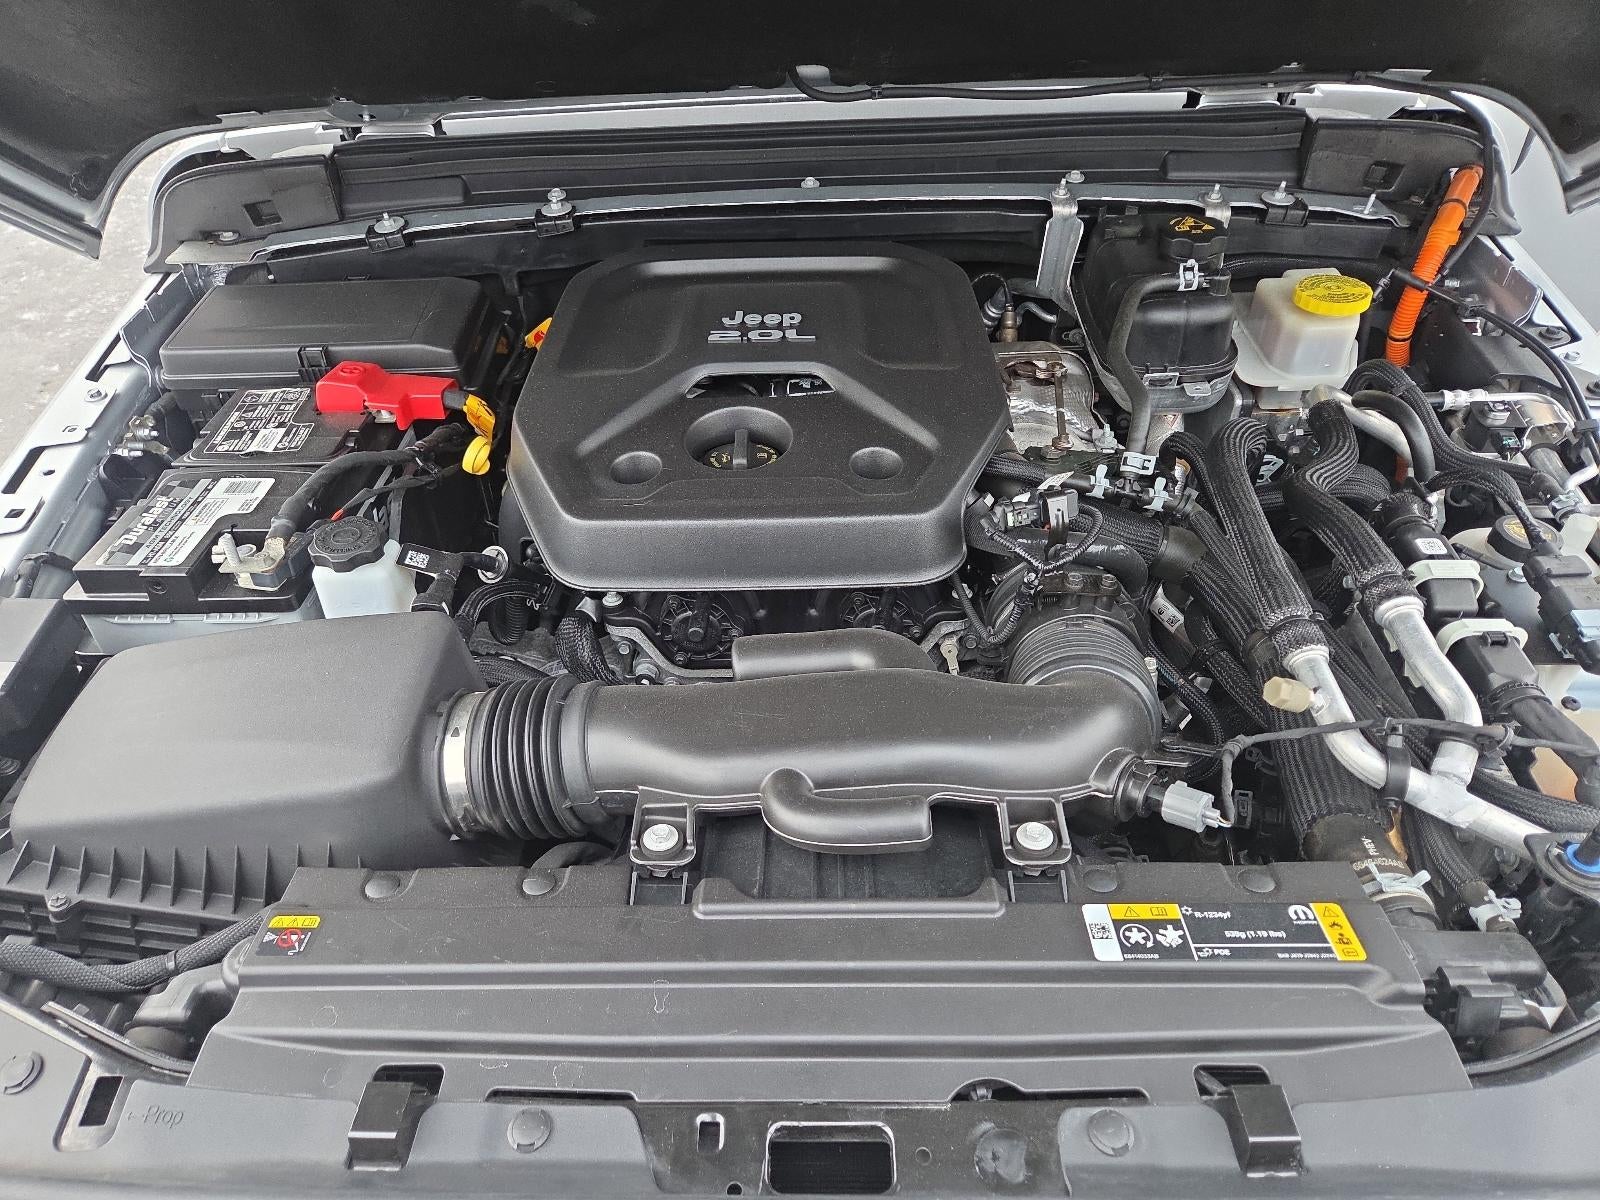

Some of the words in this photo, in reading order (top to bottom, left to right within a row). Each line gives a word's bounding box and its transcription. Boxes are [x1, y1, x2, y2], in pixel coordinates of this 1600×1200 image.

[721, 310, 802, 328] Jeep
[707, 329, 816, 343] 2.0L
[120, 494, 176, 546] Duralast
[145, 534, 161, 549] AGM
[160, 496, 194, 535] TECHNOLOGY
[147, 497, 182, 533] PLATINUM
[143, 1105, 184, 1129] Prop
